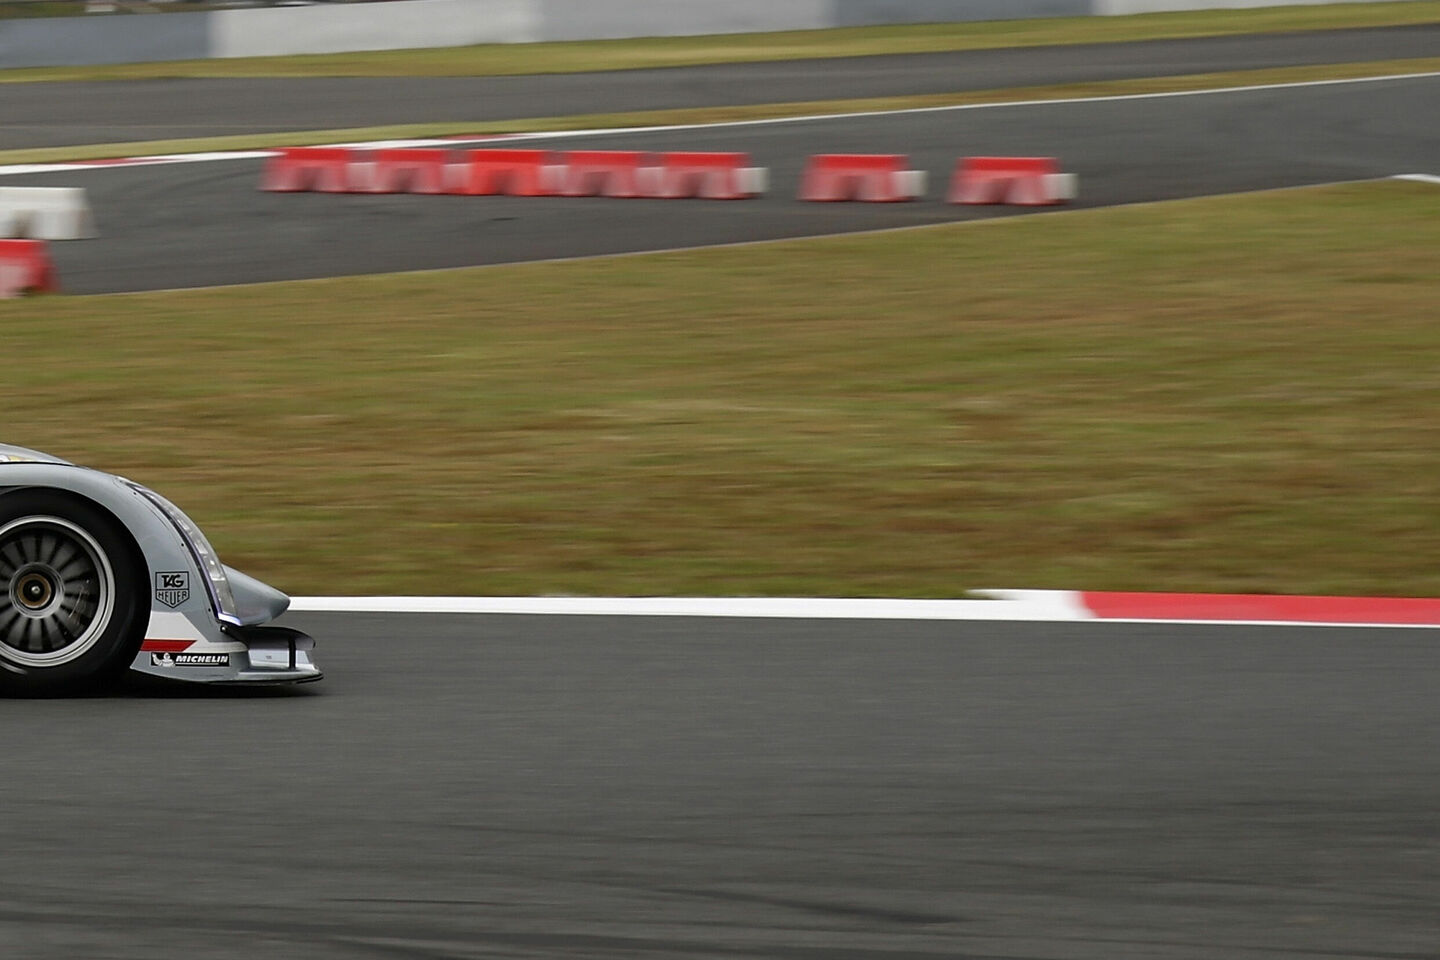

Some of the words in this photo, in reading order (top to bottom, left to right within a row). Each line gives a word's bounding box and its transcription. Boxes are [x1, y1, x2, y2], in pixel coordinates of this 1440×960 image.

[161, 575, 184, 588] TAG
[158, 591, 187, 605] HEUER
[176, 655, 229, 663] MICHELIN
